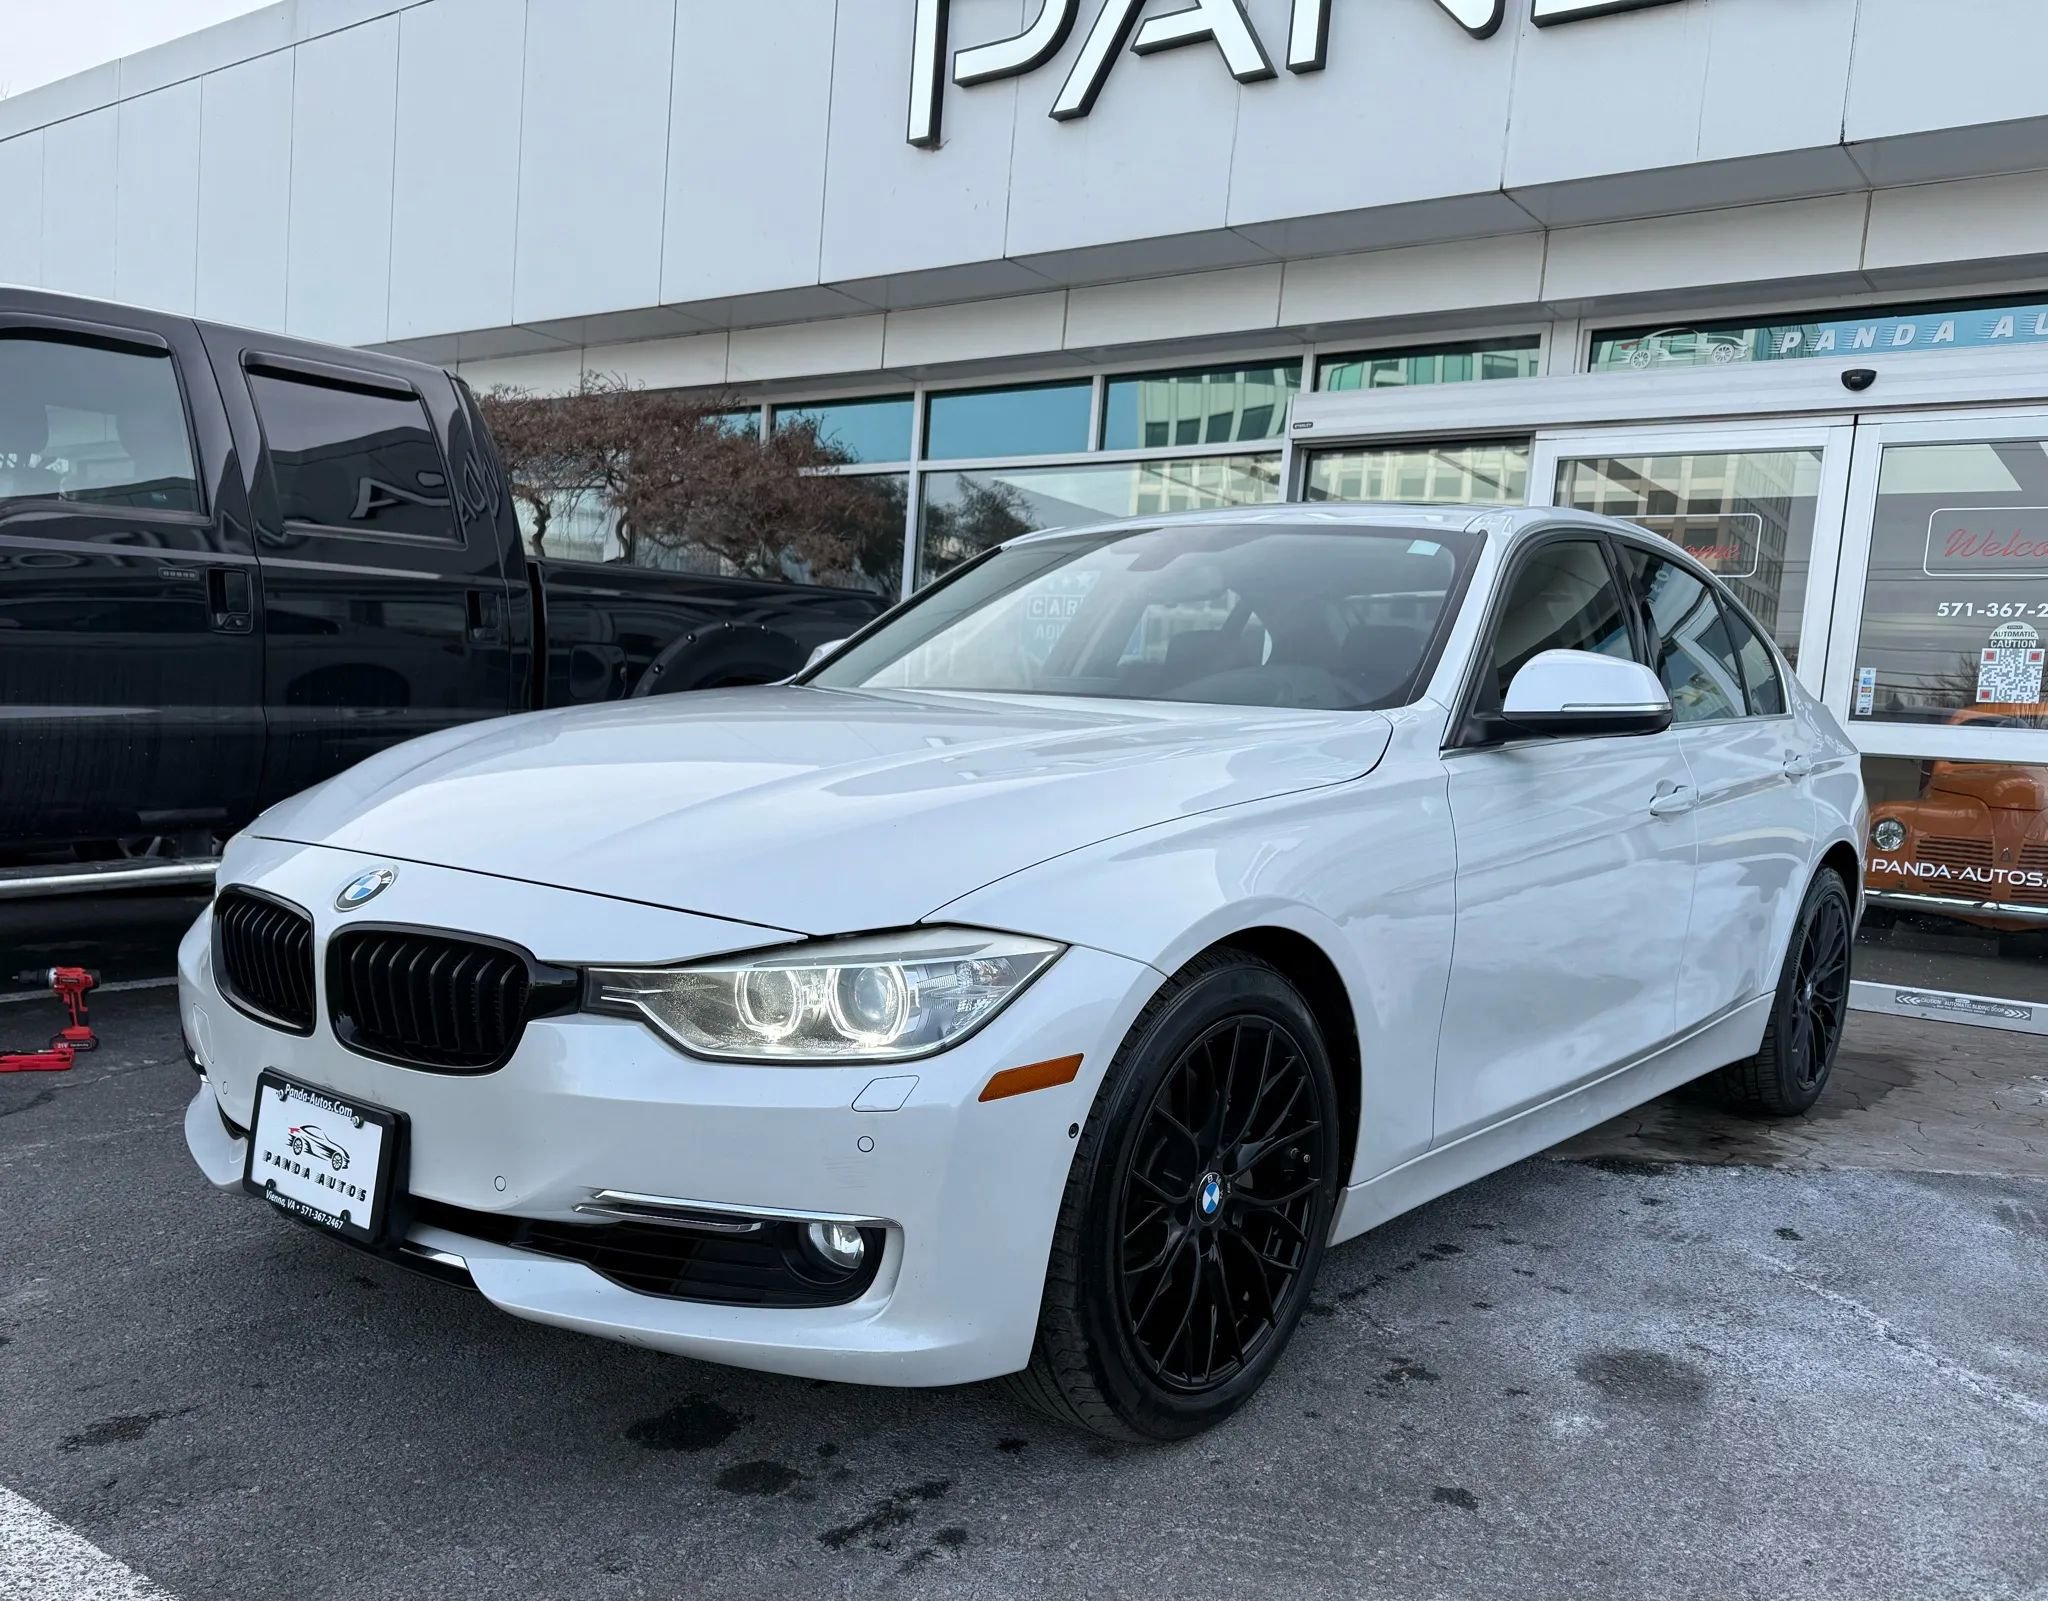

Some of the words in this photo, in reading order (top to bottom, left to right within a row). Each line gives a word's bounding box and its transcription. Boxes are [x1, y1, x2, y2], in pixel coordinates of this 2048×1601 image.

[1772, 320, 1954, 353] PANDA
[1990, 639, 2037, 648] CAUTION
[1871, 858, 2048, 888] PANDA-AUTOS.
[285, 1083, 353, 1117] Panda-Autos.Com
[264, 1150, 310, 1180] PANDA
[315, 1173, 367, 1202] AUTOS
[265, 1189, 287, 1208] Vienna,
[287, 1199, 296, 1211] VA
[300, 1205, 344, 1230] 571-367-2467
